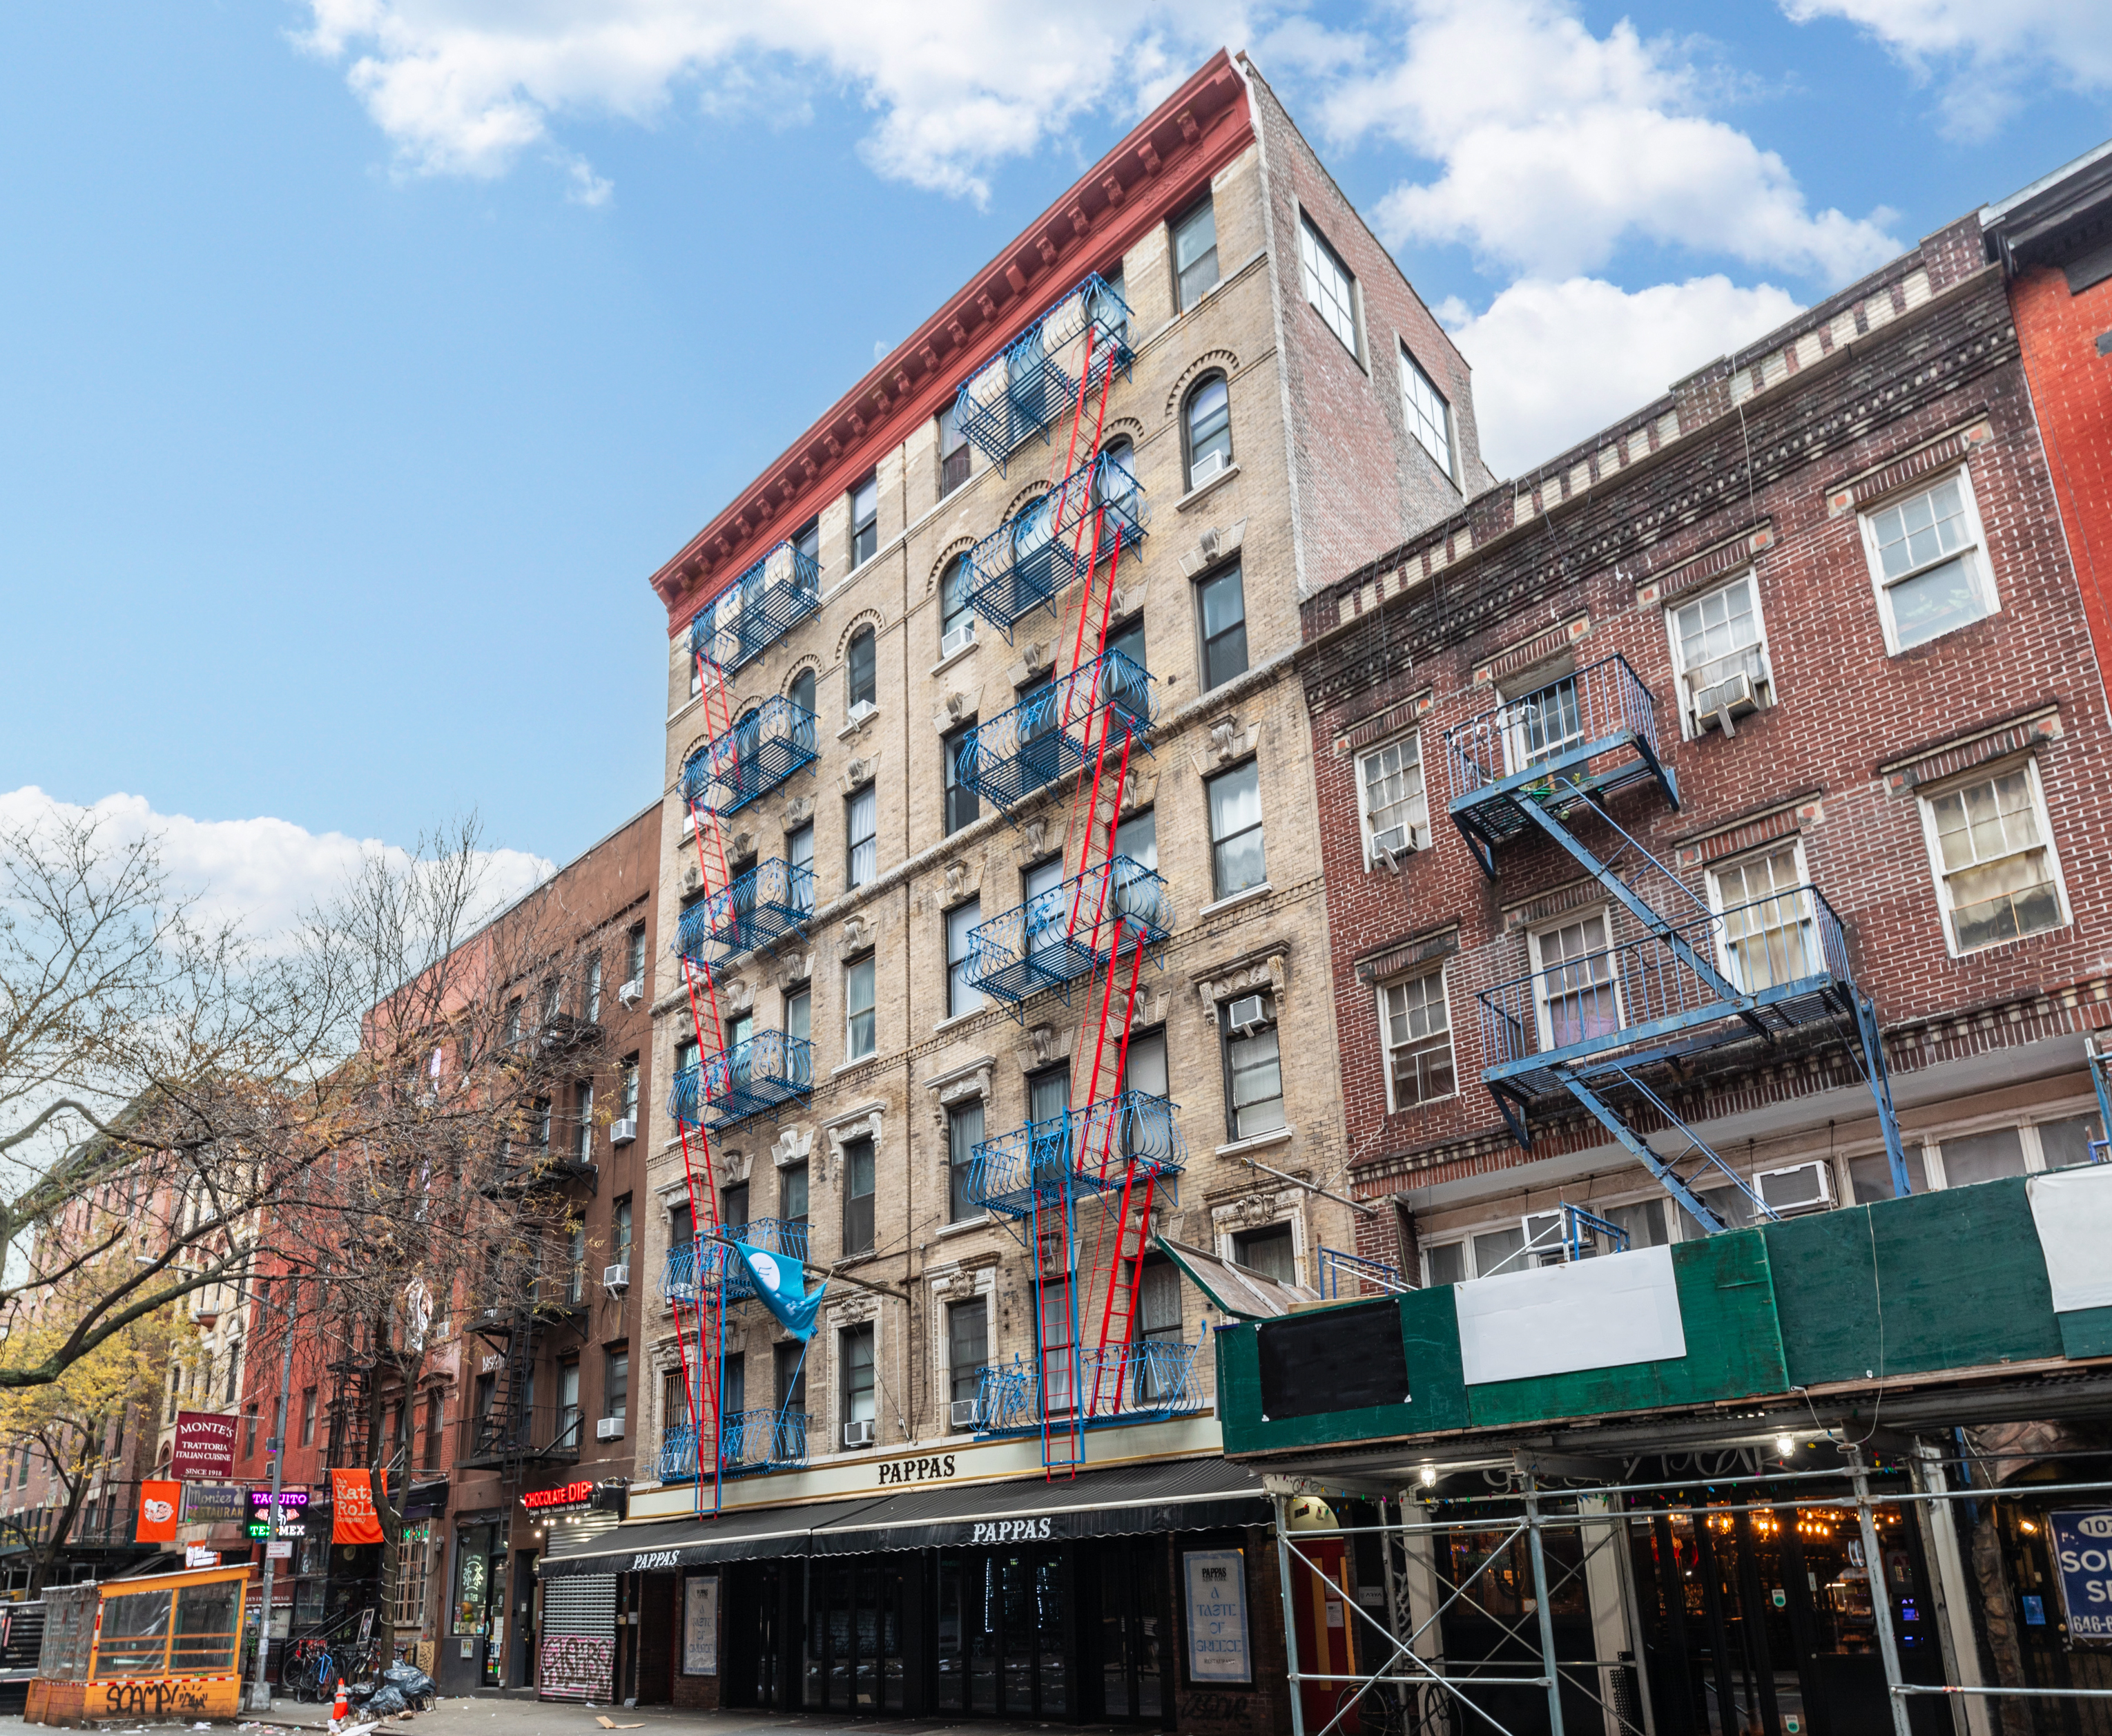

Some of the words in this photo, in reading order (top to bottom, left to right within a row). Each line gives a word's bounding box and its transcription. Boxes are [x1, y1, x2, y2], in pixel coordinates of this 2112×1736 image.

[180, 1422, 233, 1438] MONTE'S
[182, 1441, 228, 1452] TRATTORIA
[175, 1451, 203, 1460] ITALIAN
[204, 1452, 231, 1461] CUISINE
[878, 1455, 955, 1485] PAPPAS
[525, 1487, 566, 1508] CHOCOLATE
[568, 1481, 591, 1502] DIP
[336, 1516, 367, 1524] Company
[278, 1525, 305, 1536] MEX
[971, 1517, 1052, 1543] PAPPAS
[632, 1550, 680, 1570] PAPPAS
[1202, 1568, 1227, 1578] PAPPAS
[1211, 1587, 1220, 1599] A
[1197, 1604, 1237, 1617] TASTE
[1210, 1622, 1225, 1634] OF
[1196, 1639, 1241, 1652] GREECE
